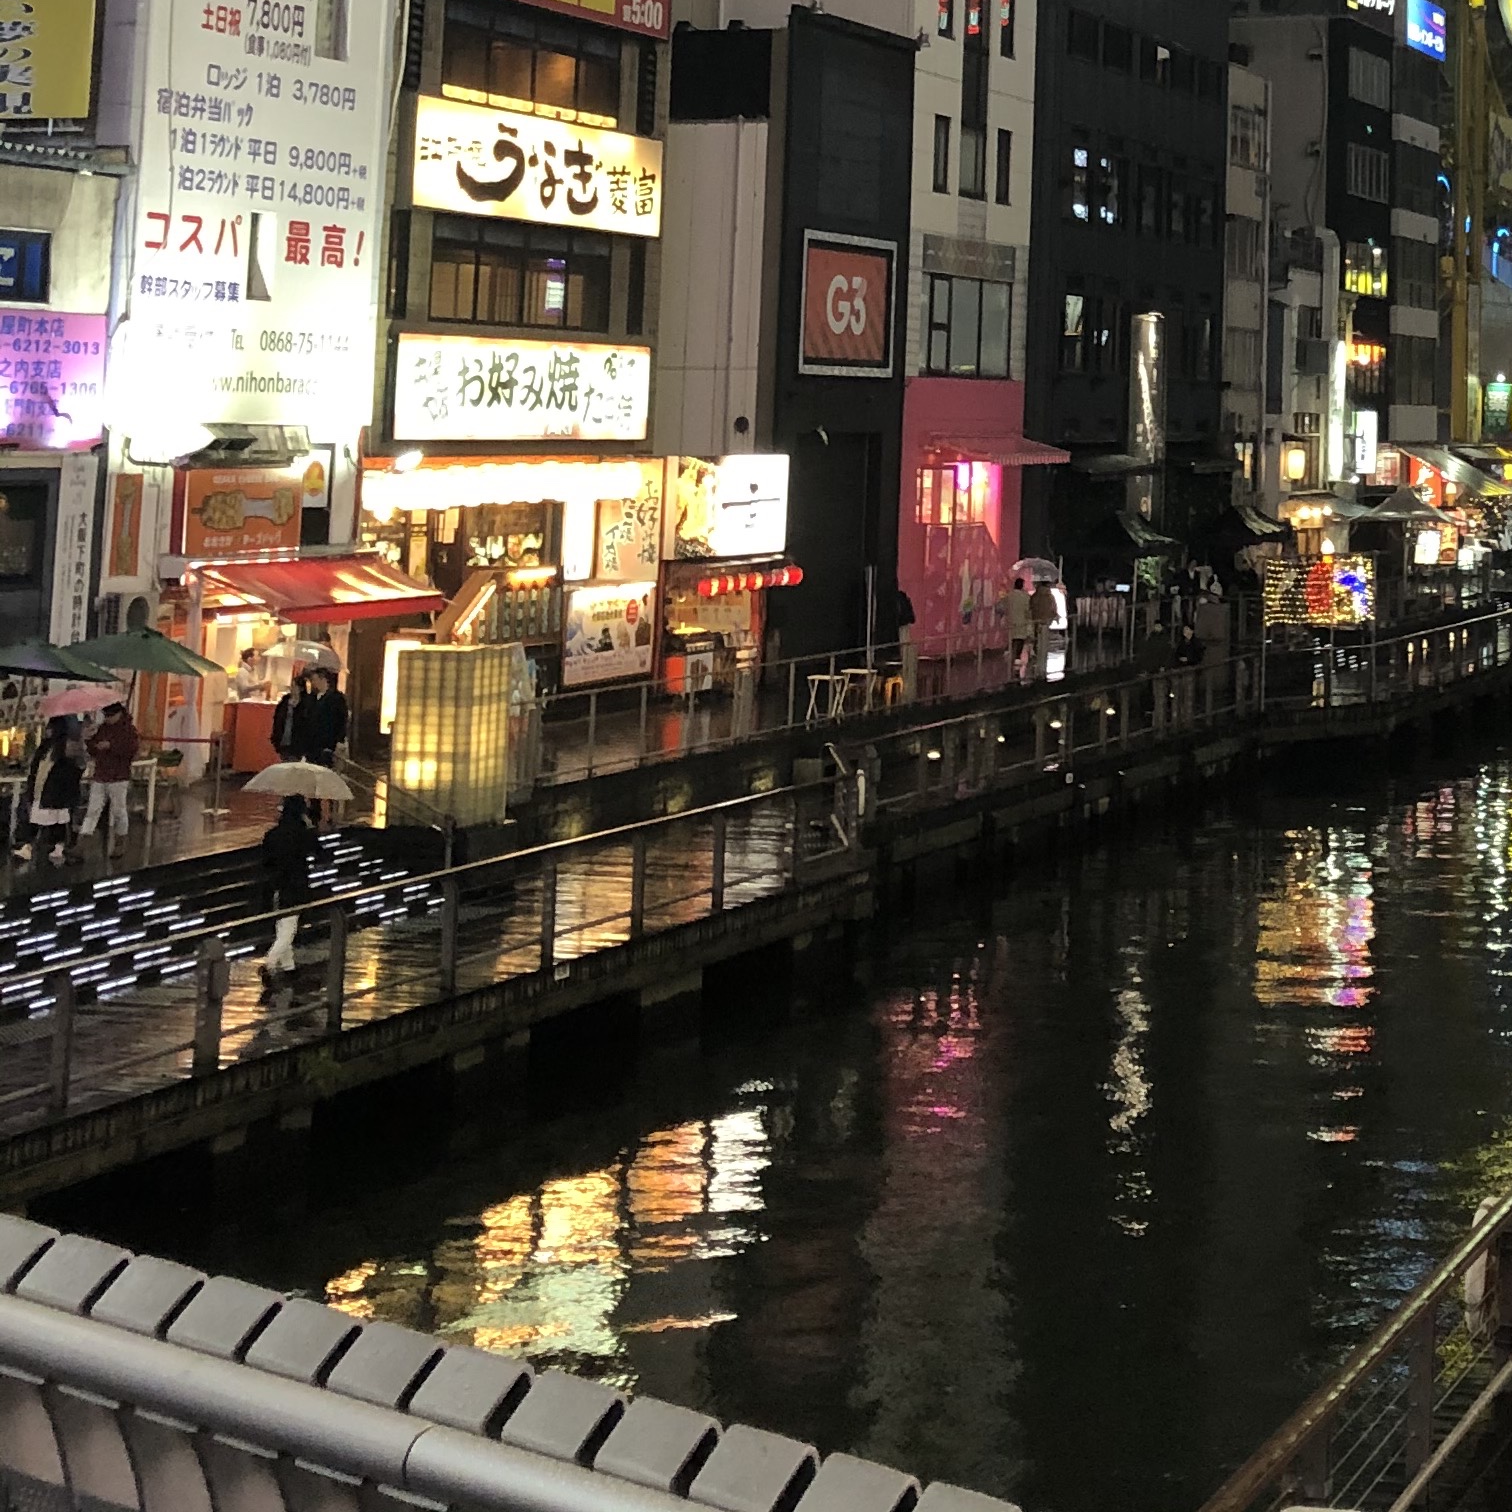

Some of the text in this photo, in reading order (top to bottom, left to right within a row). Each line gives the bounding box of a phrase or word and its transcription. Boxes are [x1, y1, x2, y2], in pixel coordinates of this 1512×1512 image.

[201, 2, 242, 37] 土日祝
[256, 71, 282, 99] 1泊
[292, 78, 357, 111] 3,780円
[247, 137, 279, 166] 平日
[456, 122, 603, 216] うなぎ
[245, 173, 276, 202] 平日
[144, 211, 243, 257] コスパ
[826, 274, 867, 336] G3
[456, 350, 580, 412] お好み焼
